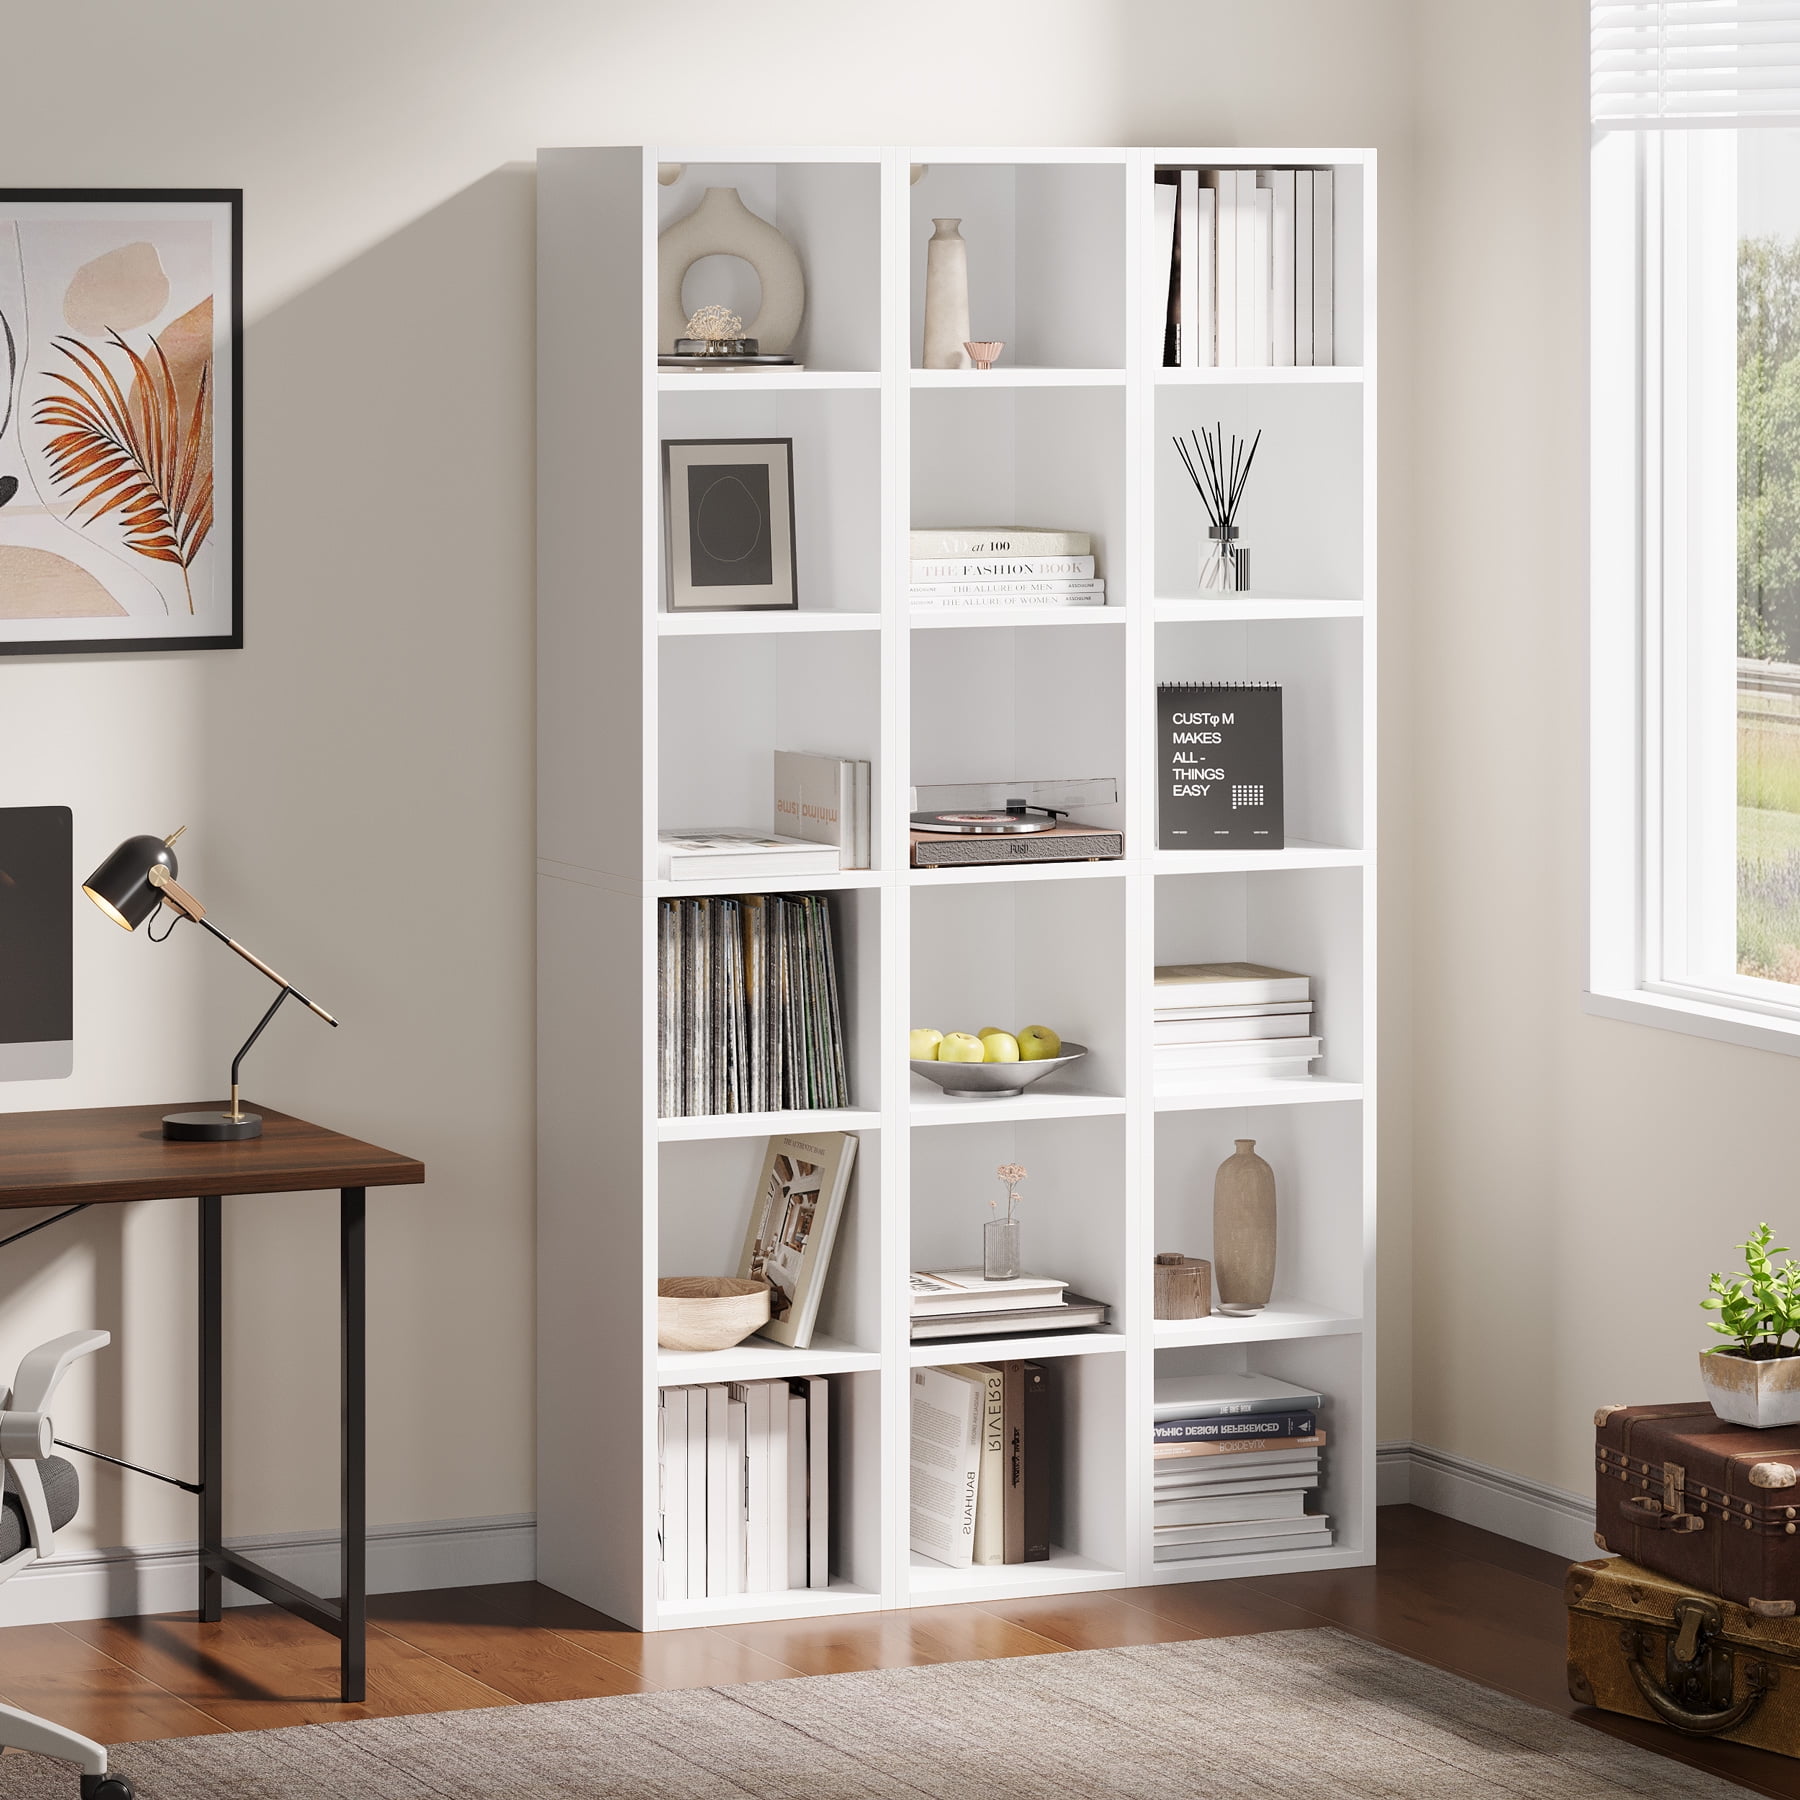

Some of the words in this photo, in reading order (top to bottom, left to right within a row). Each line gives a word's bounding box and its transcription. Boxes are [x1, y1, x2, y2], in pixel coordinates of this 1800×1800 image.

[971, 543, 985, 553] at
[989, 541, 1010, 552] 100
[922, 565, 959, 577] THE
[963, 563, 1033, 576] FASHION
[1040, 562, 1082, 574] BOOK
[953, 585, 971, 593] THE
[974, 584, 1013, 593] ALLURE
[1015, 584, 1027, 592] OF
[1030, 583, 1053, 591] MEN
[964, 598, 1000, 606] ALLURE
[1020, 596, 1058, 604] WOMEN
[1172, 732, 1222, 744] MAKES
[1172, 768, 1225, 780] THINGS
[1172, 785, 1211, 797] EASY
